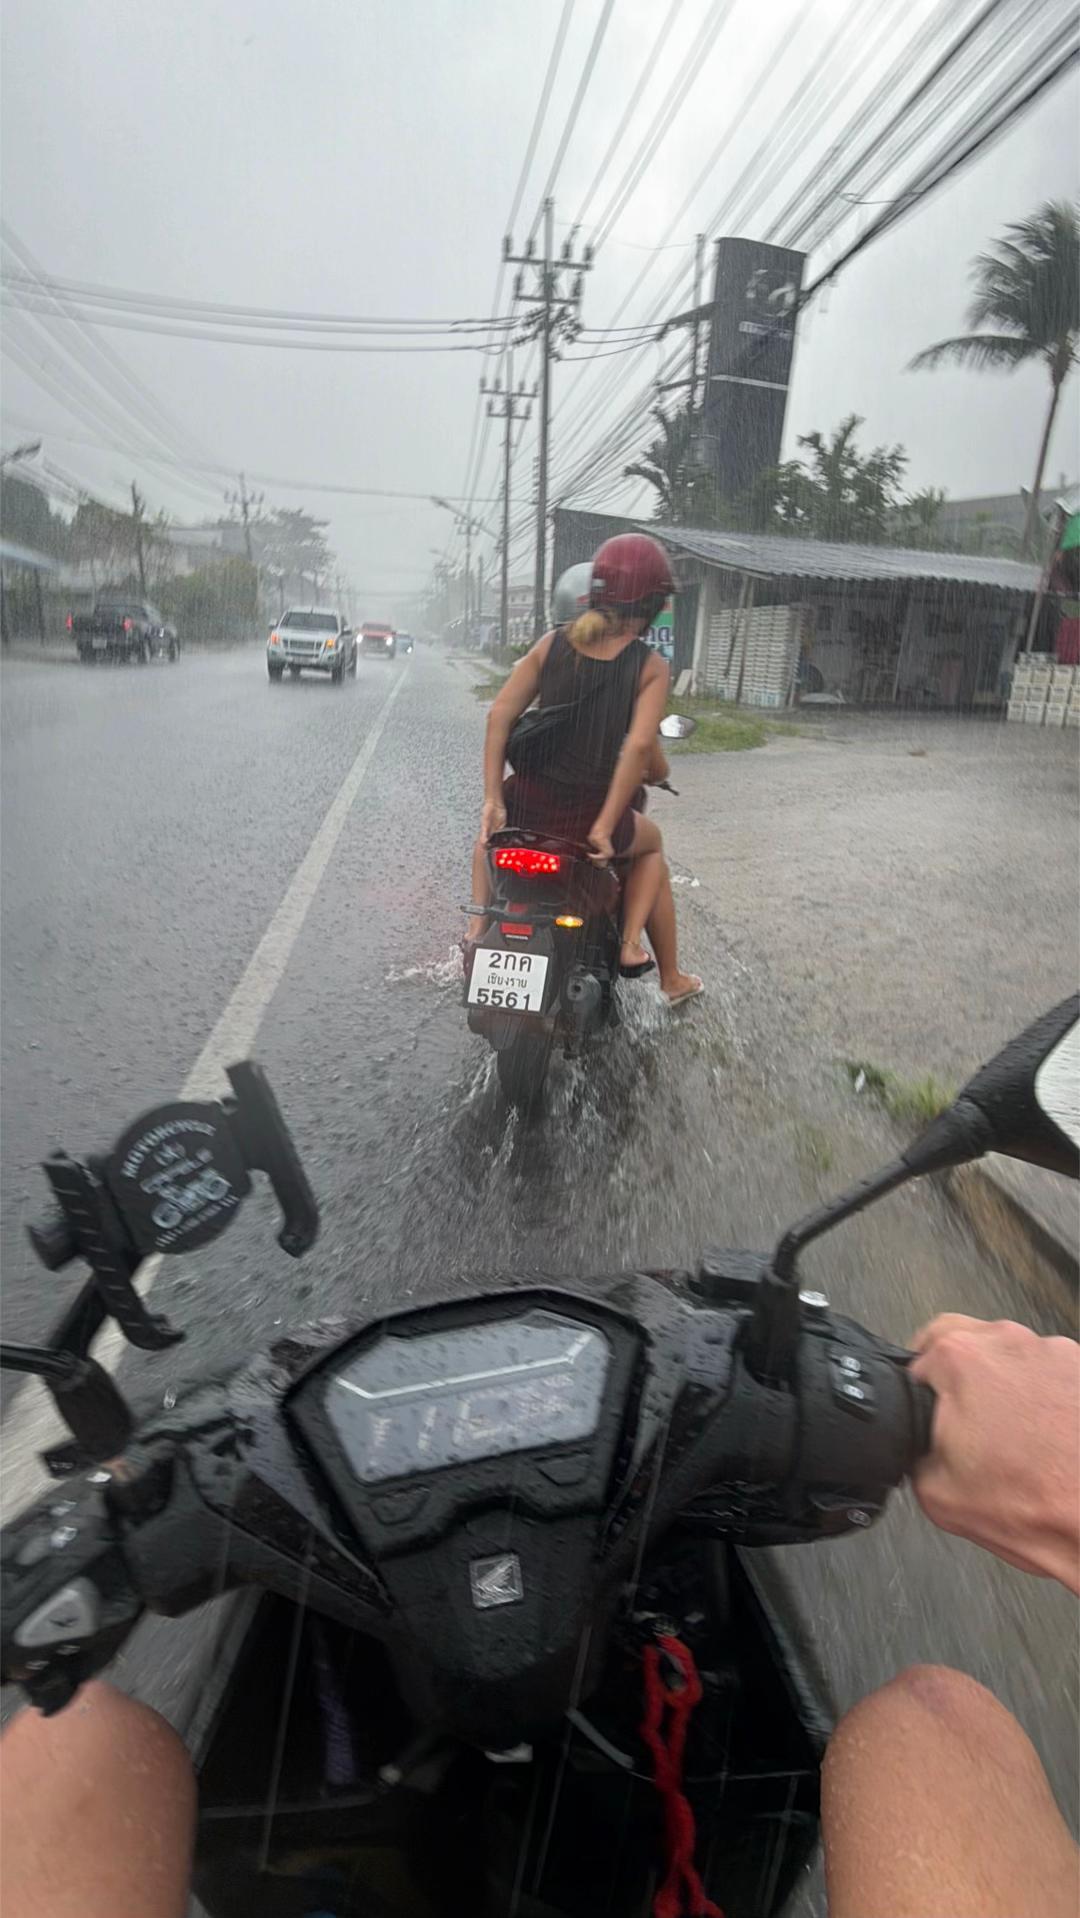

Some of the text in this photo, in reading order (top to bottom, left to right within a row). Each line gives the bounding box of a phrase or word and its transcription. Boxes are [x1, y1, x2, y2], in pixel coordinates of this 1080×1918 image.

[489, 952, 532, 972] 2กค
[487, 972, 528, 988] เชียงราย
[476, 987, 530, 1011] 5561
